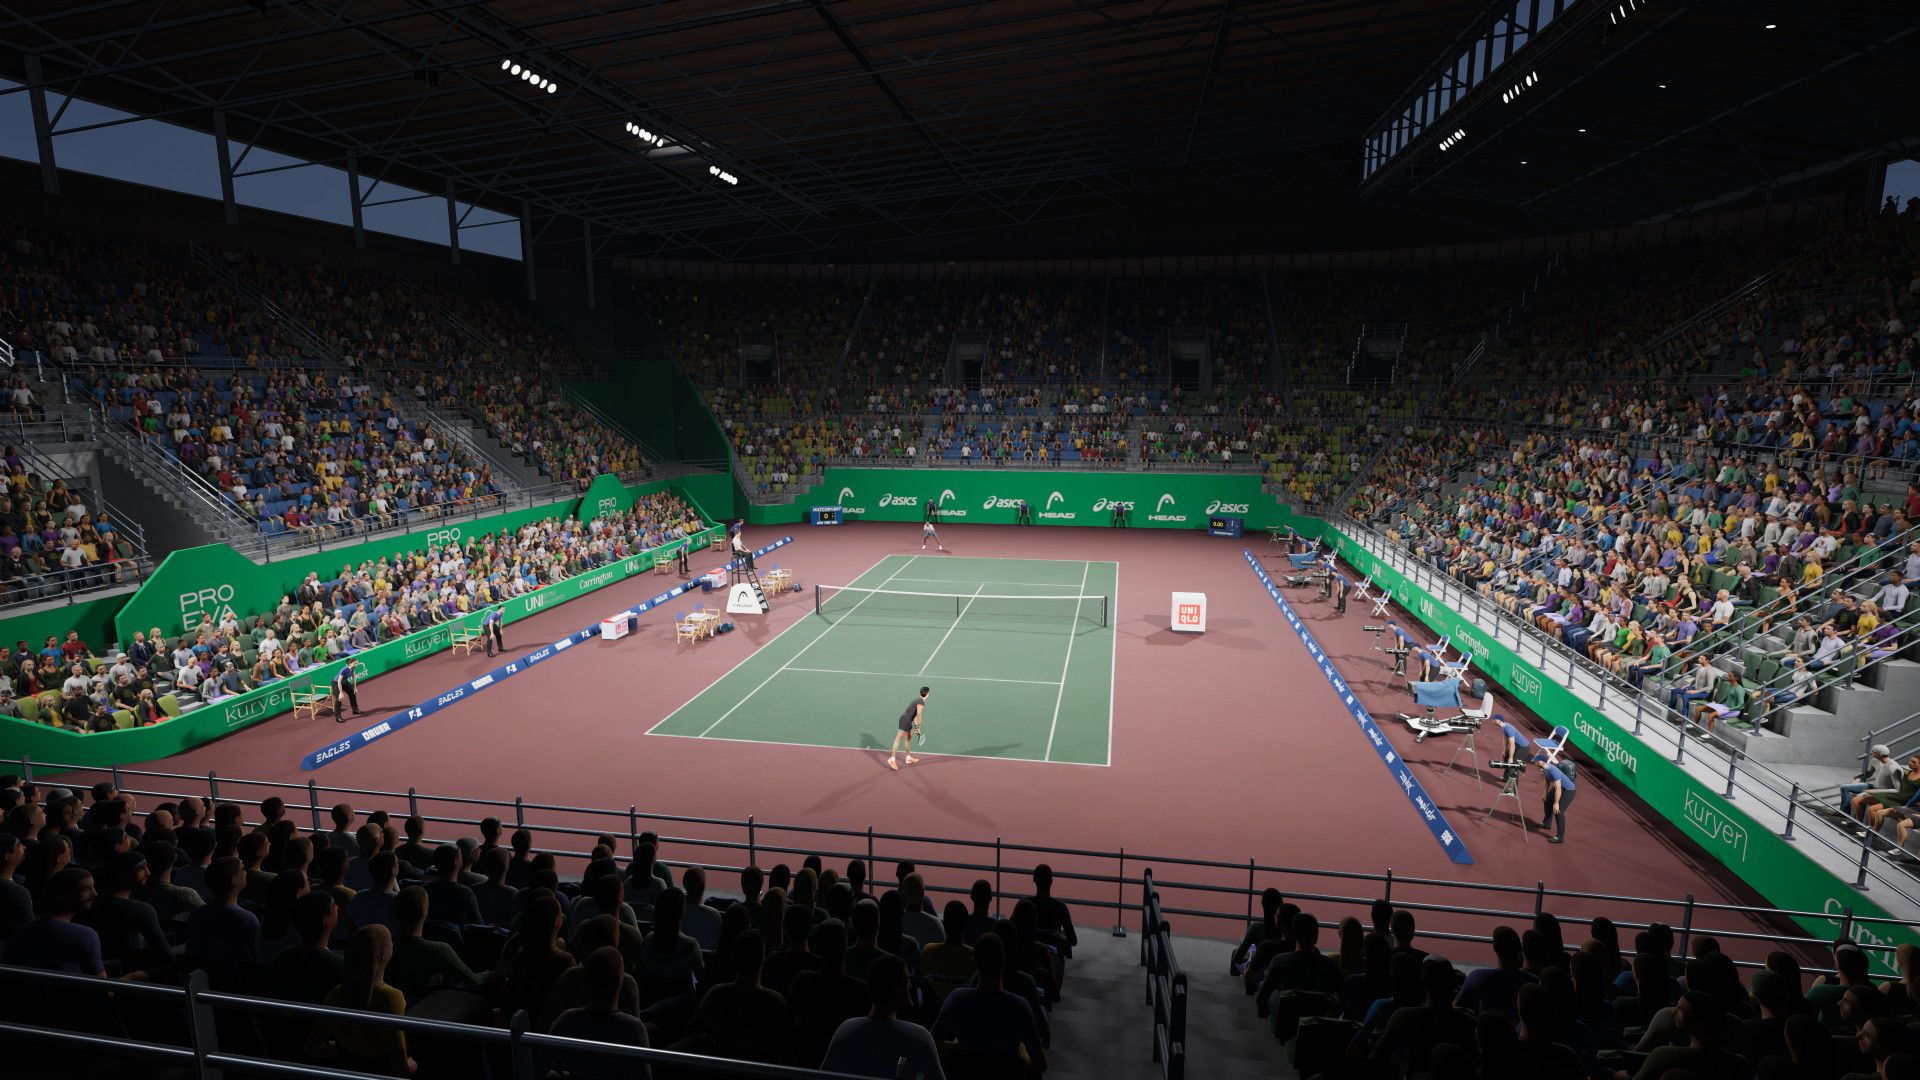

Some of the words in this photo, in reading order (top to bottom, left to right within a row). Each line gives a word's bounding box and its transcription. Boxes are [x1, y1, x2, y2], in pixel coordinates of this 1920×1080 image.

[599, 497, 617, 510] PRO
[891, 496, 918, 506] asics
[1219, 503, 1249, 513] asics
[1149, 514, 1187, 522] HEAD
[427, 527, 461, 547] PRO
[579, 570, 613, 589] Carrington
[179, 584, 235, 613] PRO
[525, 593, 544, 612] UNI
[1181, 606, 1198, 614] UNI
[1181, 614, 1199, 624] QLO
[404, 630, 448, 655] kuryer
[1455, 624, 1489, 660] Carrington
[1512, 663, 1539, 695] kuryer
[225, 689, 289, 723] kuryer
[438, 688, 464, 706] EAGLES
[1573, 711, 1637, 773] Carrington
[316, 740, 351, 764] EAGLES
[1684, 788, 1743, 849] kuryer
